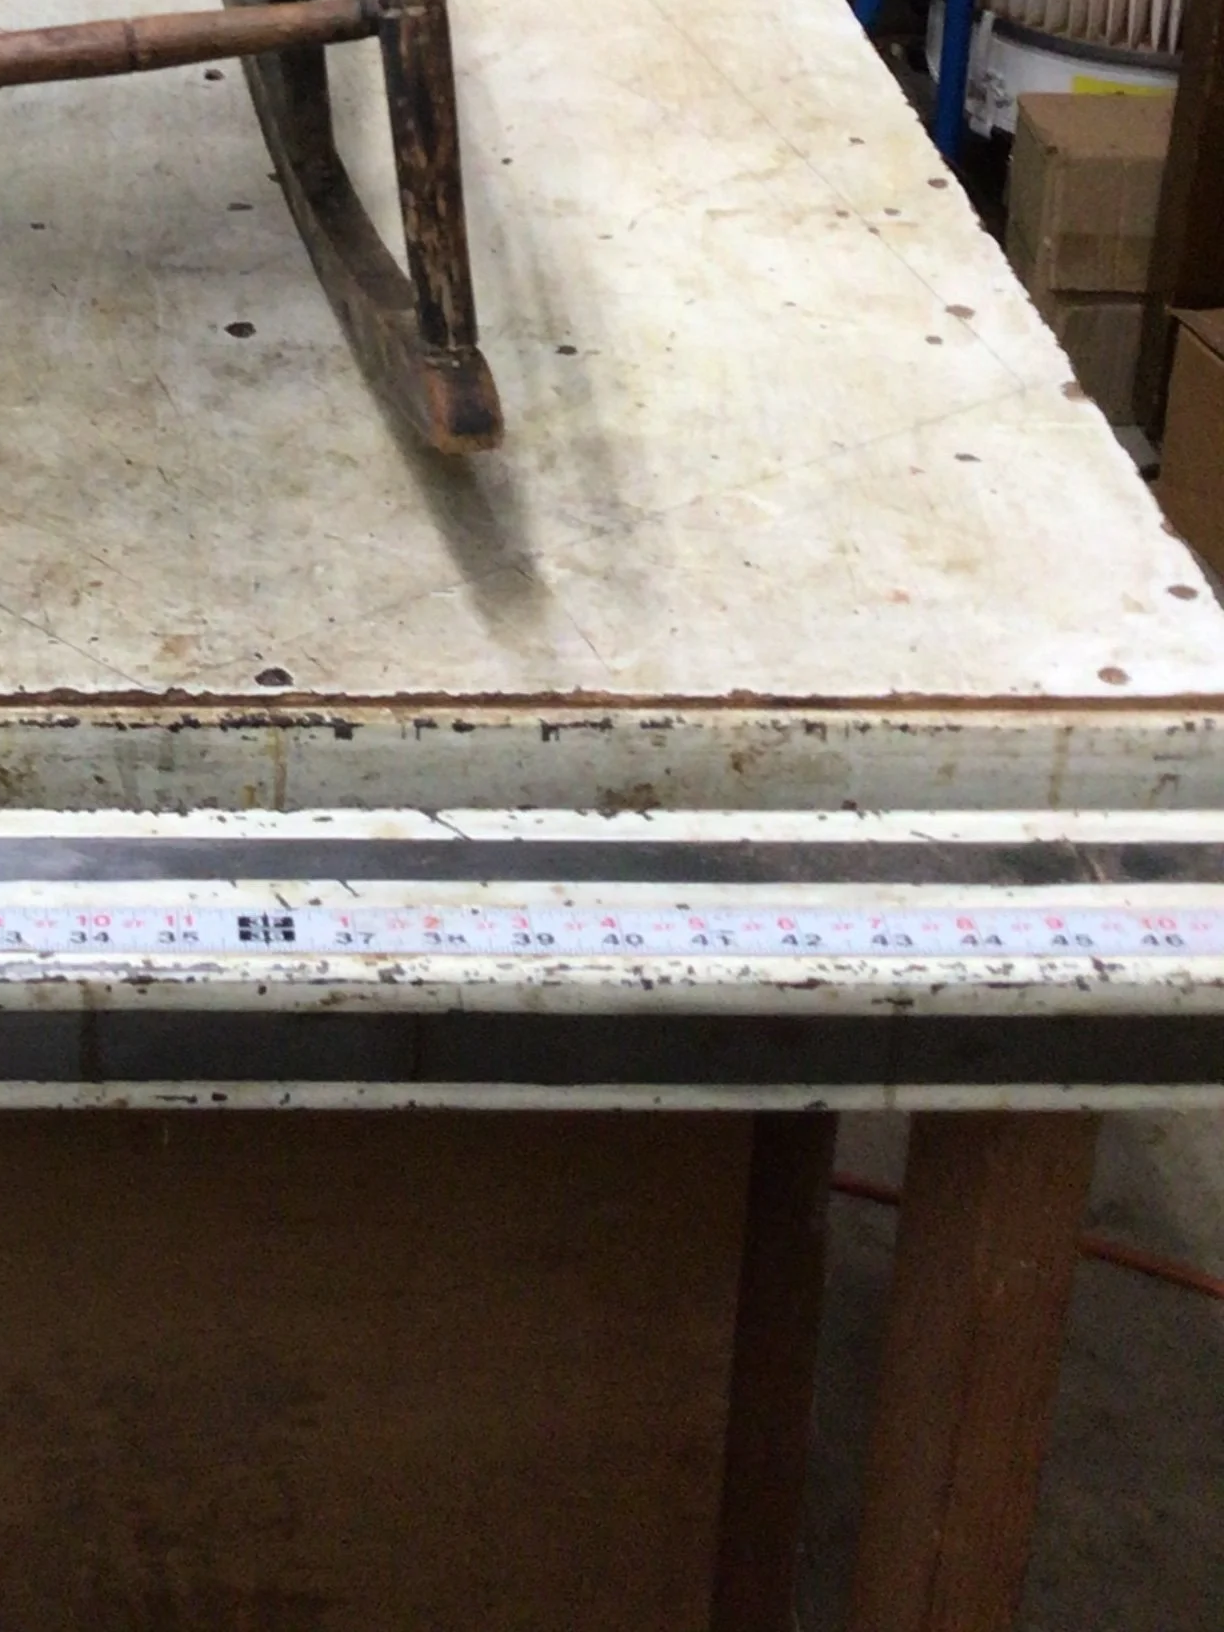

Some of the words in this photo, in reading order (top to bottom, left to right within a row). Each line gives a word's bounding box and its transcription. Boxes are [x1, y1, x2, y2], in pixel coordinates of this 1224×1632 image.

[77, 915, 111, 927] 10
[70, 931, 110, 943] 34
[336, 932, 374, 945] 37
[512, 932, 555, 945] 39
[603, 933, 644, 946] 40
[782, 933, 822, 946] 42
